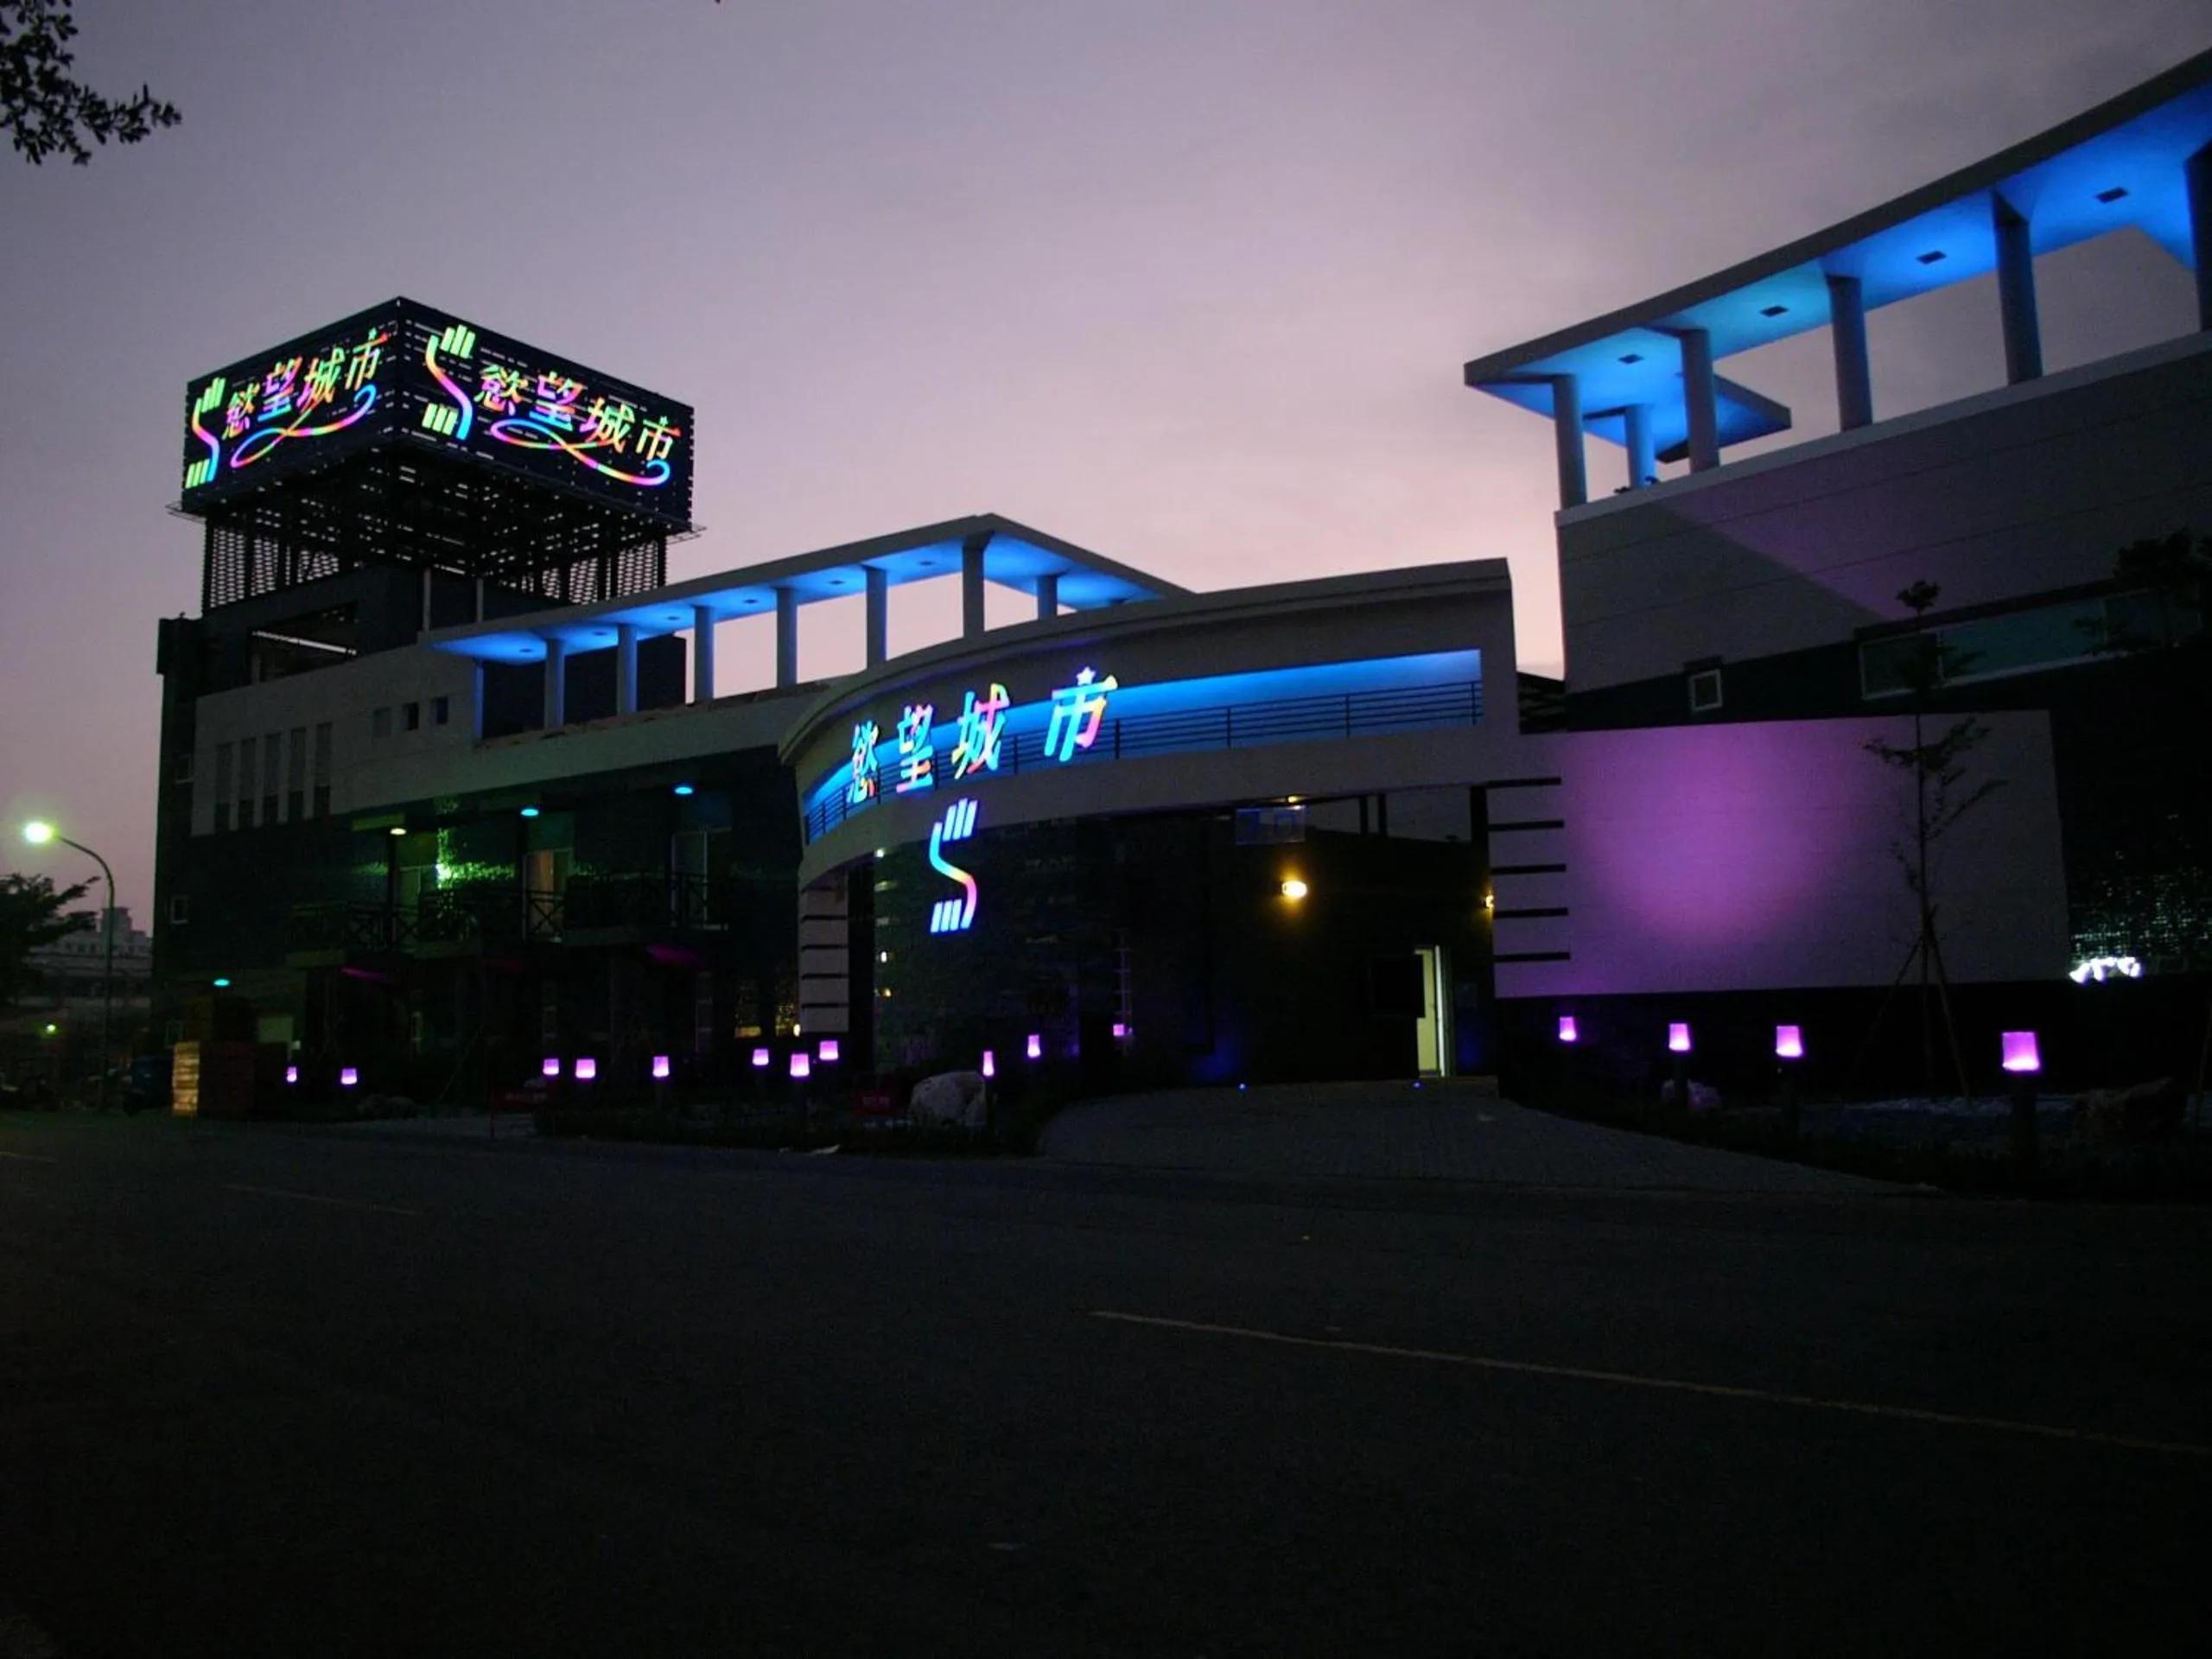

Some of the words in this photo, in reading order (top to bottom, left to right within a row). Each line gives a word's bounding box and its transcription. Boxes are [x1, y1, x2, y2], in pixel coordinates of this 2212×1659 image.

[222, 327, 389, 440] 慾望城市
[474, 364, 681, 461] 慾望城市
[846, 666, 1118, 804] 慾望城市
